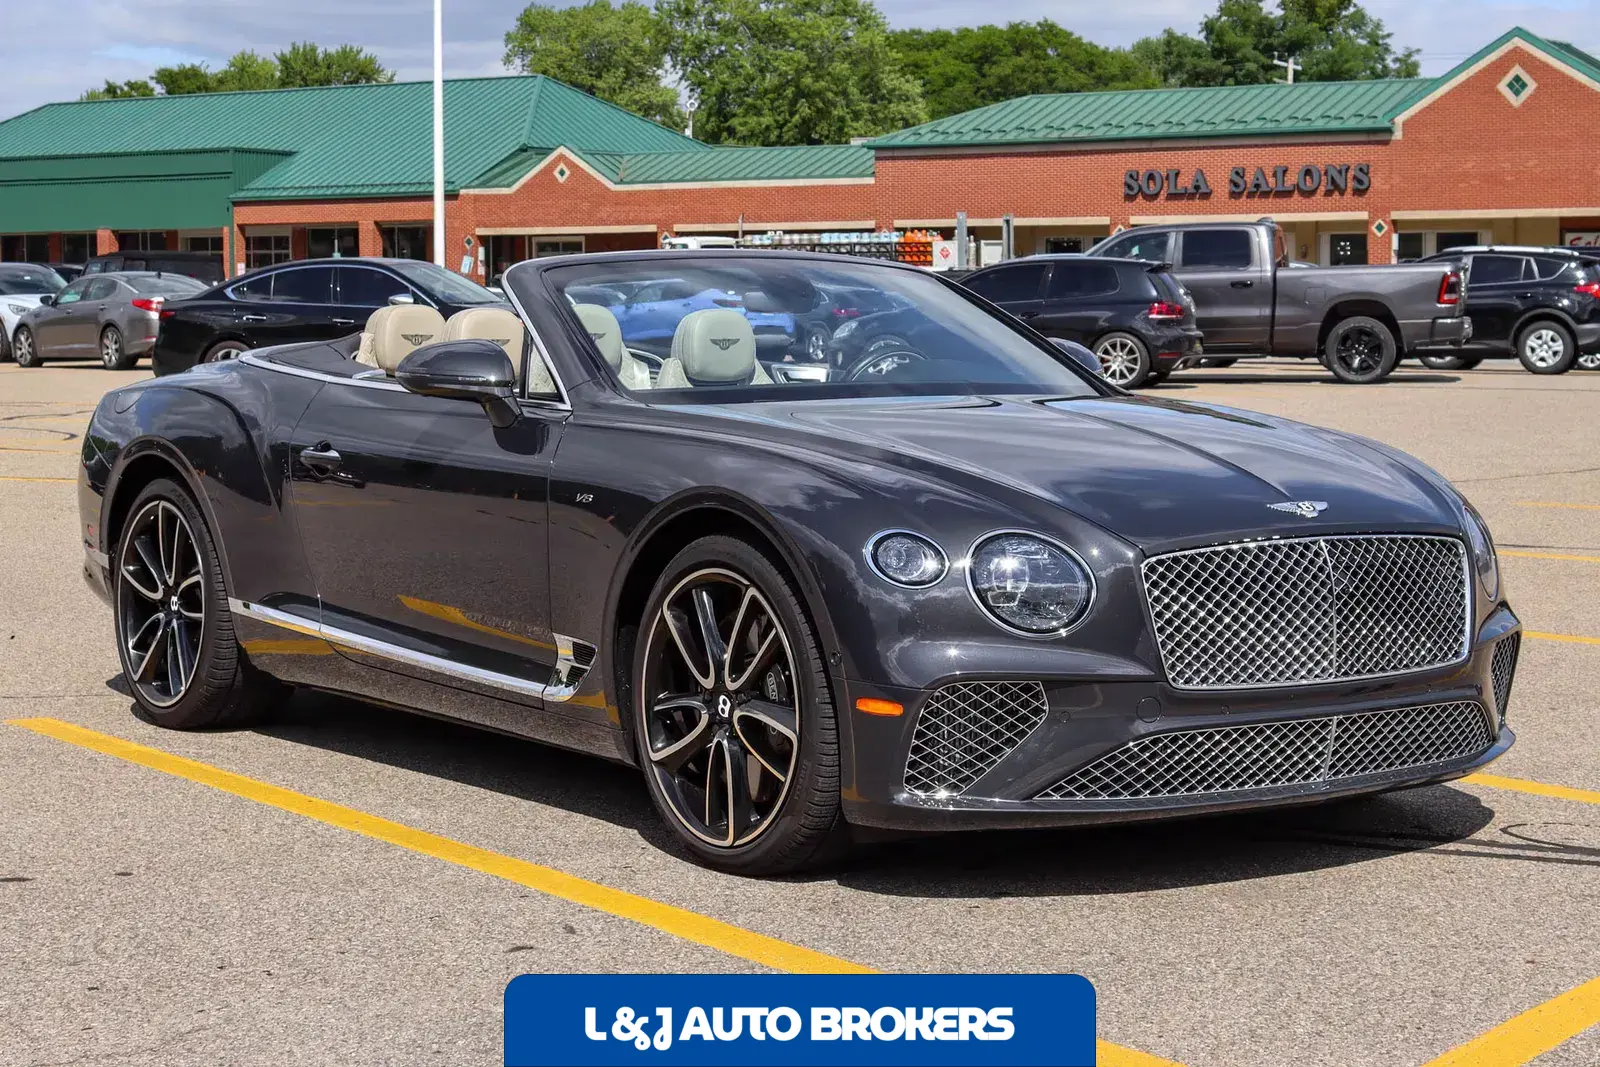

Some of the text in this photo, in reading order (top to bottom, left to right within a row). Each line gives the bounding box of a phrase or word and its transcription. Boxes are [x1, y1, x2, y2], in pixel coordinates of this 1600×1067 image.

[1124, 163, 1371, 197] SOLA SALONS
[576, 493, 593, 503] V8
